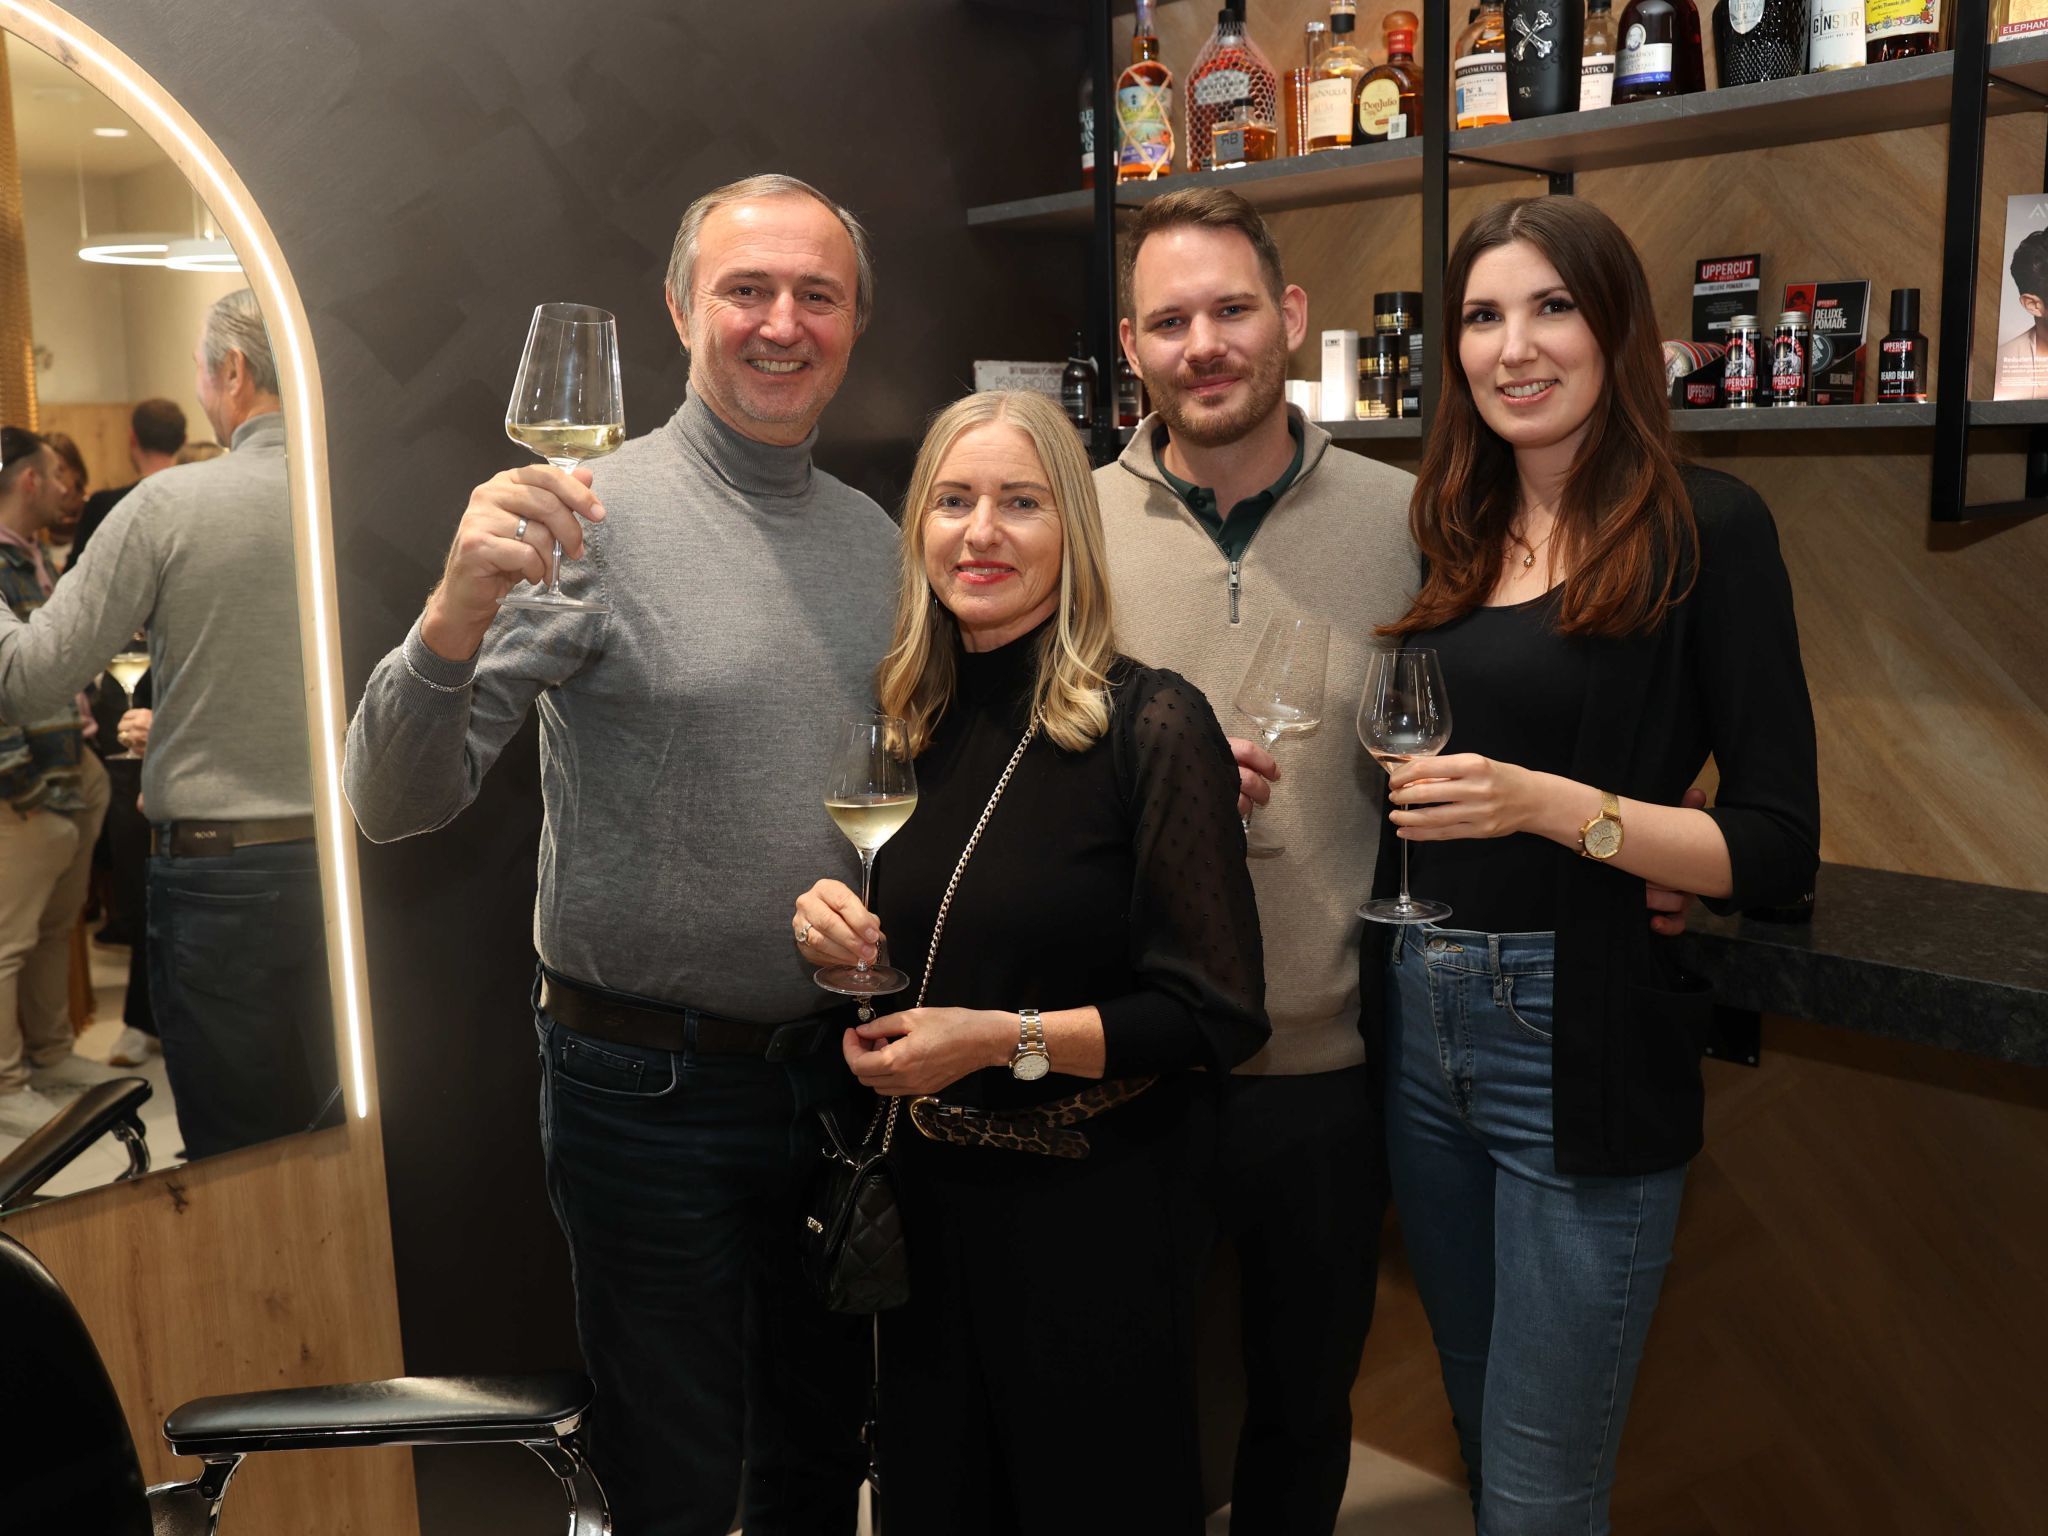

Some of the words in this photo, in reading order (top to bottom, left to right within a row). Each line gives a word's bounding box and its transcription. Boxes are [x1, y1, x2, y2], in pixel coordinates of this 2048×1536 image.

[1702, 260, 1753, 279] UPPERCUT
[1815, 308, 1844, 320] DELUXE
[1813, 318, 1848, 329] POMADE
[1883, 341, 1913, 351] UPPERCUT
[1880, 370, 1897, 381] BEARD
[1896, 370, 1915, 380] BALM
